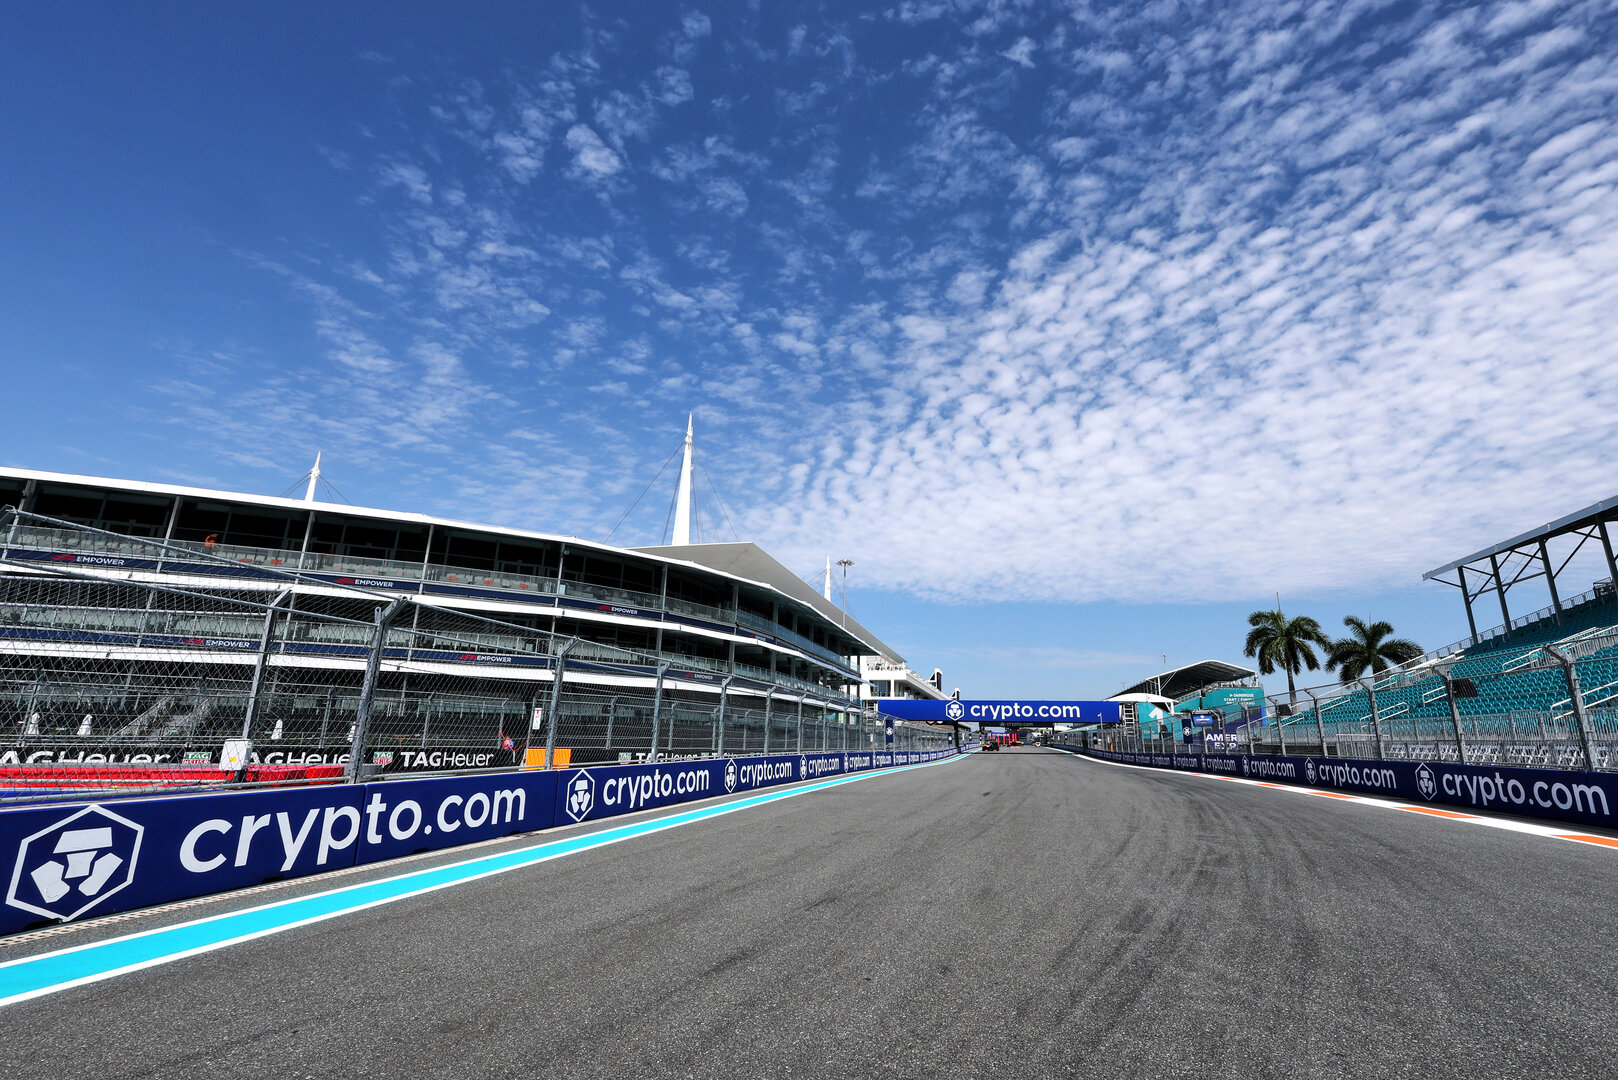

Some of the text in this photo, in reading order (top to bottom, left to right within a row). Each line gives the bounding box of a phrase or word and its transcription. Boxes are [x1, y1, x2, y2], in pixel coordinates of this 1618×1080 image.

[76, 555, 124, 566] EMPOWER
[354, 578, 393, 588] EMPOWER
[611, 606, 638, 615] EMPOWER
[205, 639, 250, 648] EMPOWER
[476, 655, 512, 663] EMPOWER
[970, 702, 1081, 720] crypto.com
[740, 760, 792, 787] crypto.com
[808, 756, 840, 776] crypto.com
[1206, 757, 1237, 772] crypto.com
[1250, 758, 1296, 778] crypto.com
[1319, 762, 1397, 789] crypto.com
[602, 768, 710, 809] crypto.com
[1442, 772, 1610, 816] crypto.com
[179, 786, 527, 873] crypto.com
